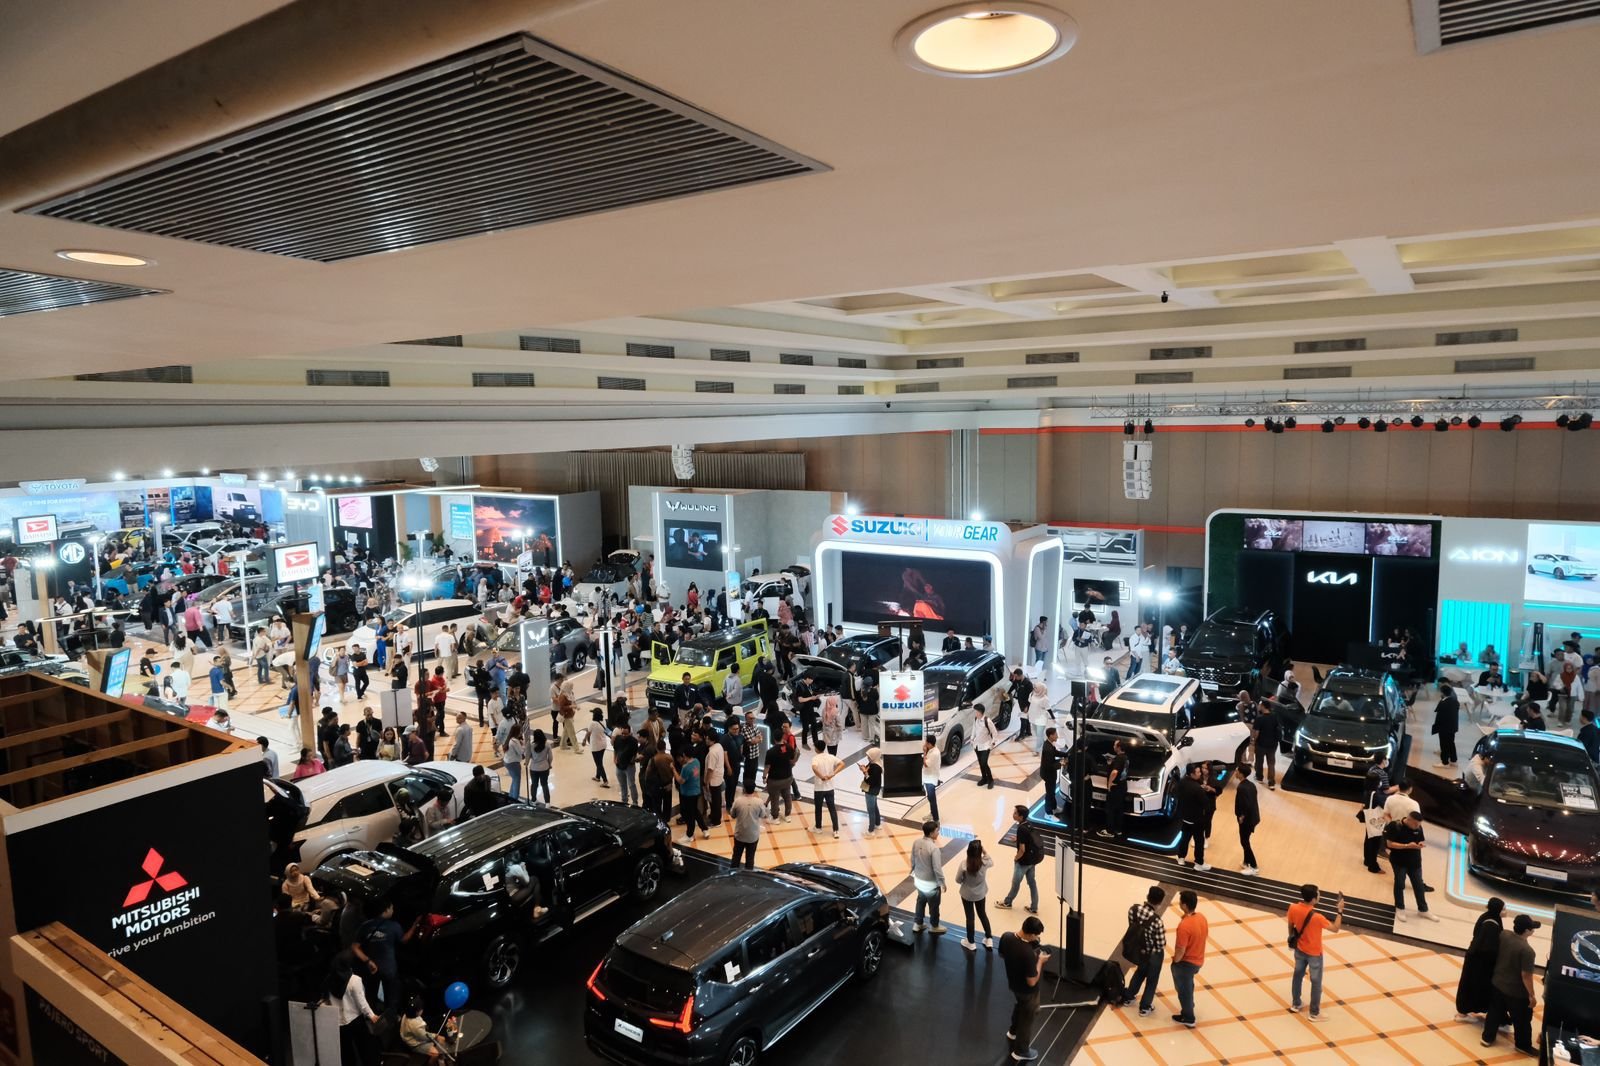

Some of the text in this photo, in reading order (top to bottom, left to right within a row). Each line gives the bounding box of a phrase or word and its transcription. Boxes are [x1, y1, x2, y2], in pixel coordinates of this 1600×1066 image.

[45, 482, 79, 490] TOYOTA
[287, 497, 320, 511] BYD
[680, 504, 717, 512] WULING
[851, 519, 922, 536] SUZUKI
[963, 525, 998, 541] GEAR
[62, 543, 83, 562] MG
[1448, 549, 1519, 563] AION
[1307, 570, 1357, 585] KIA
[882, 701, 923, 709] SUZUKI
[111, 886, 200, 929] MITSUBISHI
[125, 904, 191, 938] MOTORS
[133, 932, 161, 951] your
[163, 911, 216, 937] Ambition
